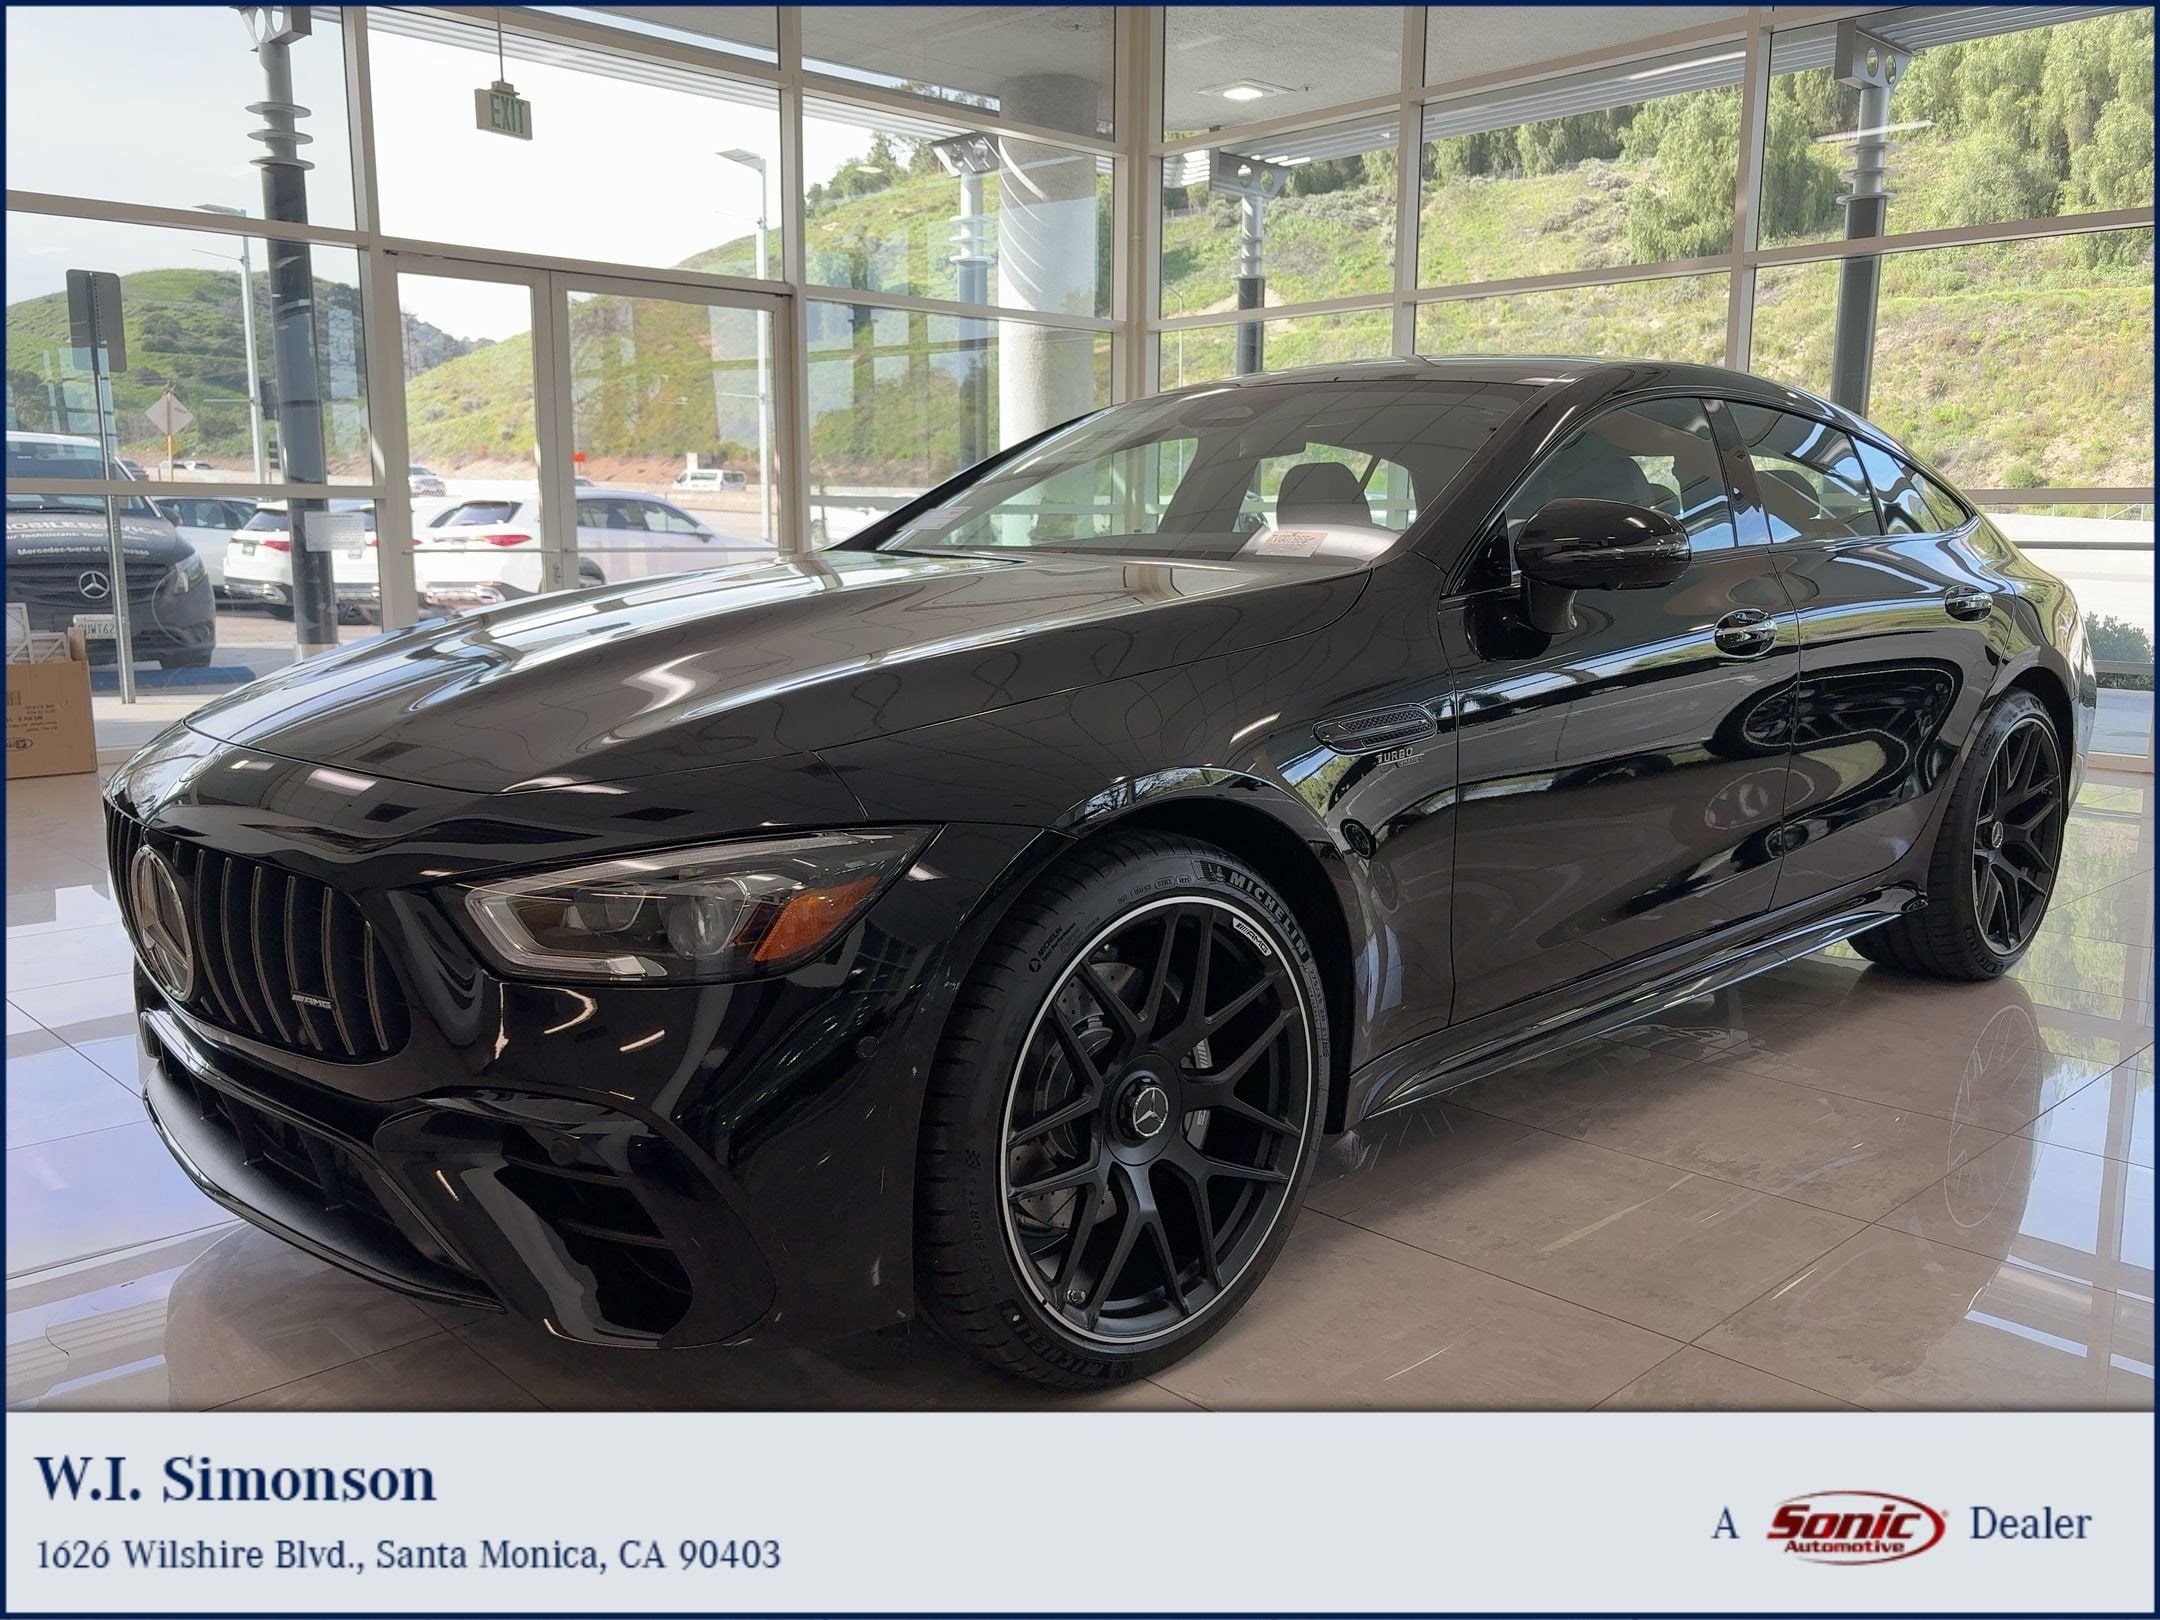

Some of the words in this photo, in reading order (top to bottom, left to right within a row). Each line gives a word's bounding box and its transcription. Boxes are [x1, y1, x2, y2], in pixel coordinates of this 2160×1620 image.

[490, 93, 524, 134] EXIT
[1375, 747, 1413, 764] TURBO
[1229, 872, 1309, 957] MICHELIN
[1038, 925, 1063, 958] MICHELIN
[968, 1199, 986, 1250] SPORT
